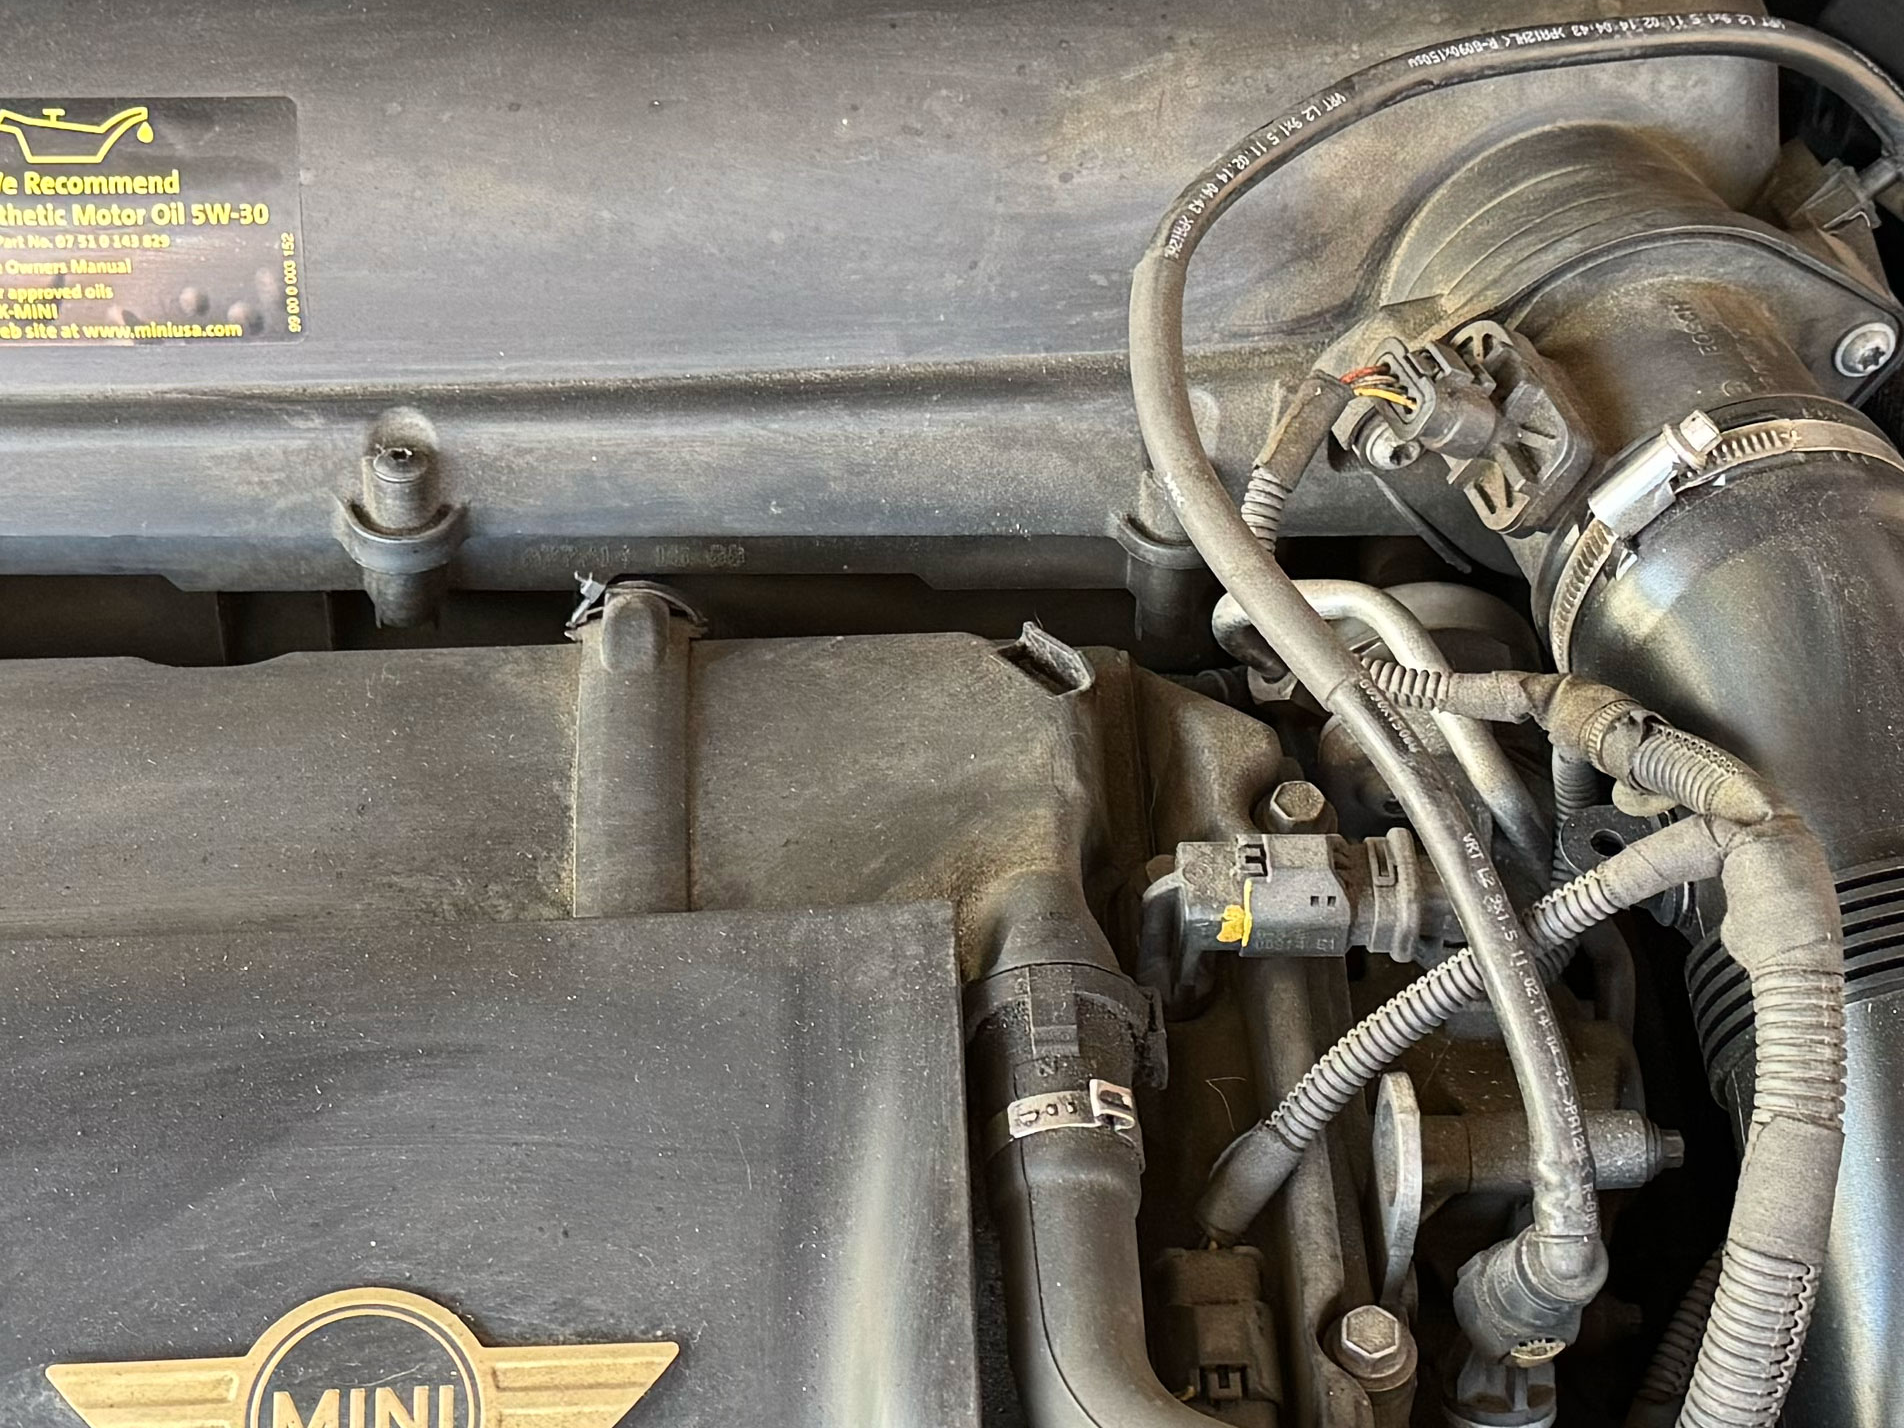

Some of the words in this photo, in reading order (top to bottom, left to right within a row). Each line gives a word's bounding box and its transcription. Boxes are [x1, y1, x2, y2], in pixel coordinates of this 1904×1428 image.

[1322, 92, 1347, 112] VRT
[1301, 105, 1322, 123] L2
[1267, 116, 1303, 147] 9x1.5
[1215, 140, 1267, 184] 11.02.14
[24, 169, 180, 195] Recommend
[72, 203, 147, 226] Motor
[151, 201, 186, 226] Oil
[191, 202, 270, 225] 5W-30
[27, 234, 53, 249] No.
[54, 235, 75, 249] 07
[77, 235, 97, 249] 51
[98, 235, 110, 249] 0
[112, 235, 140, 249] 143
[142, 234, 171, 249] 829
[280, 232, 295, 257] 152
[5, 259, 68, 275] Owners
[70, 258, 133, 274] Manual
[283, 259, 298, 285] 003
[7, 283, 82, 304] approved
[84, 283, 114, 300] oils
[285, 285, 299, 297] 0
[286, 296, 300, 314] 00
[25, 322, 58, 340] site
[60, 324, 81, 339] at
[82, 321, 243, 340] www.miniusa.com
[287, 315, 302, 333] 99
[1463, 832, 1485, 860] VRT
[1476, 867, 1496, 889] L2
